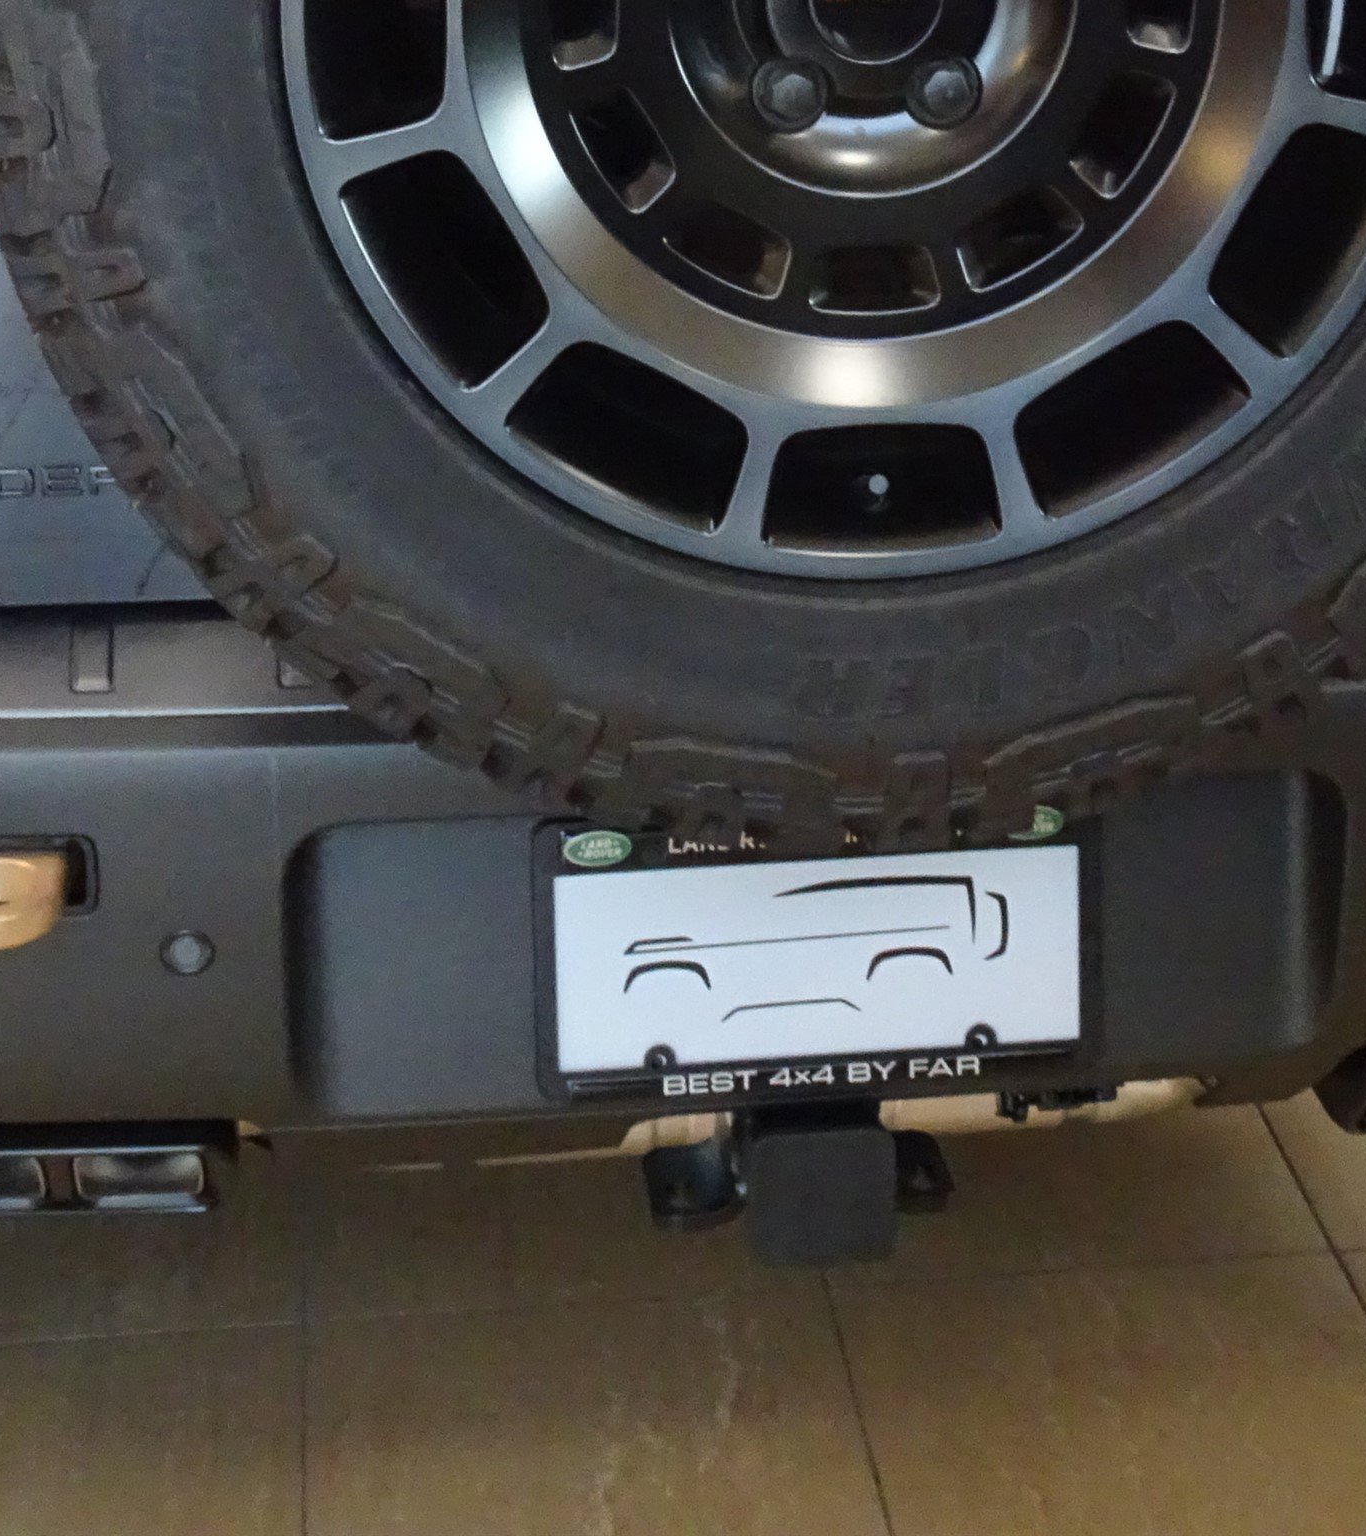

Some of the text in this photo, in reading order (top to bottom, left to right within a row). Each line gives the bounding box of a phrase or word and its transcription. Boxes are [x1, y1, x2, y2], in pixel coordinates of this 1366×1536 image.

[662, 1055, 980, 1096] BEST 4x4 BY FAR
